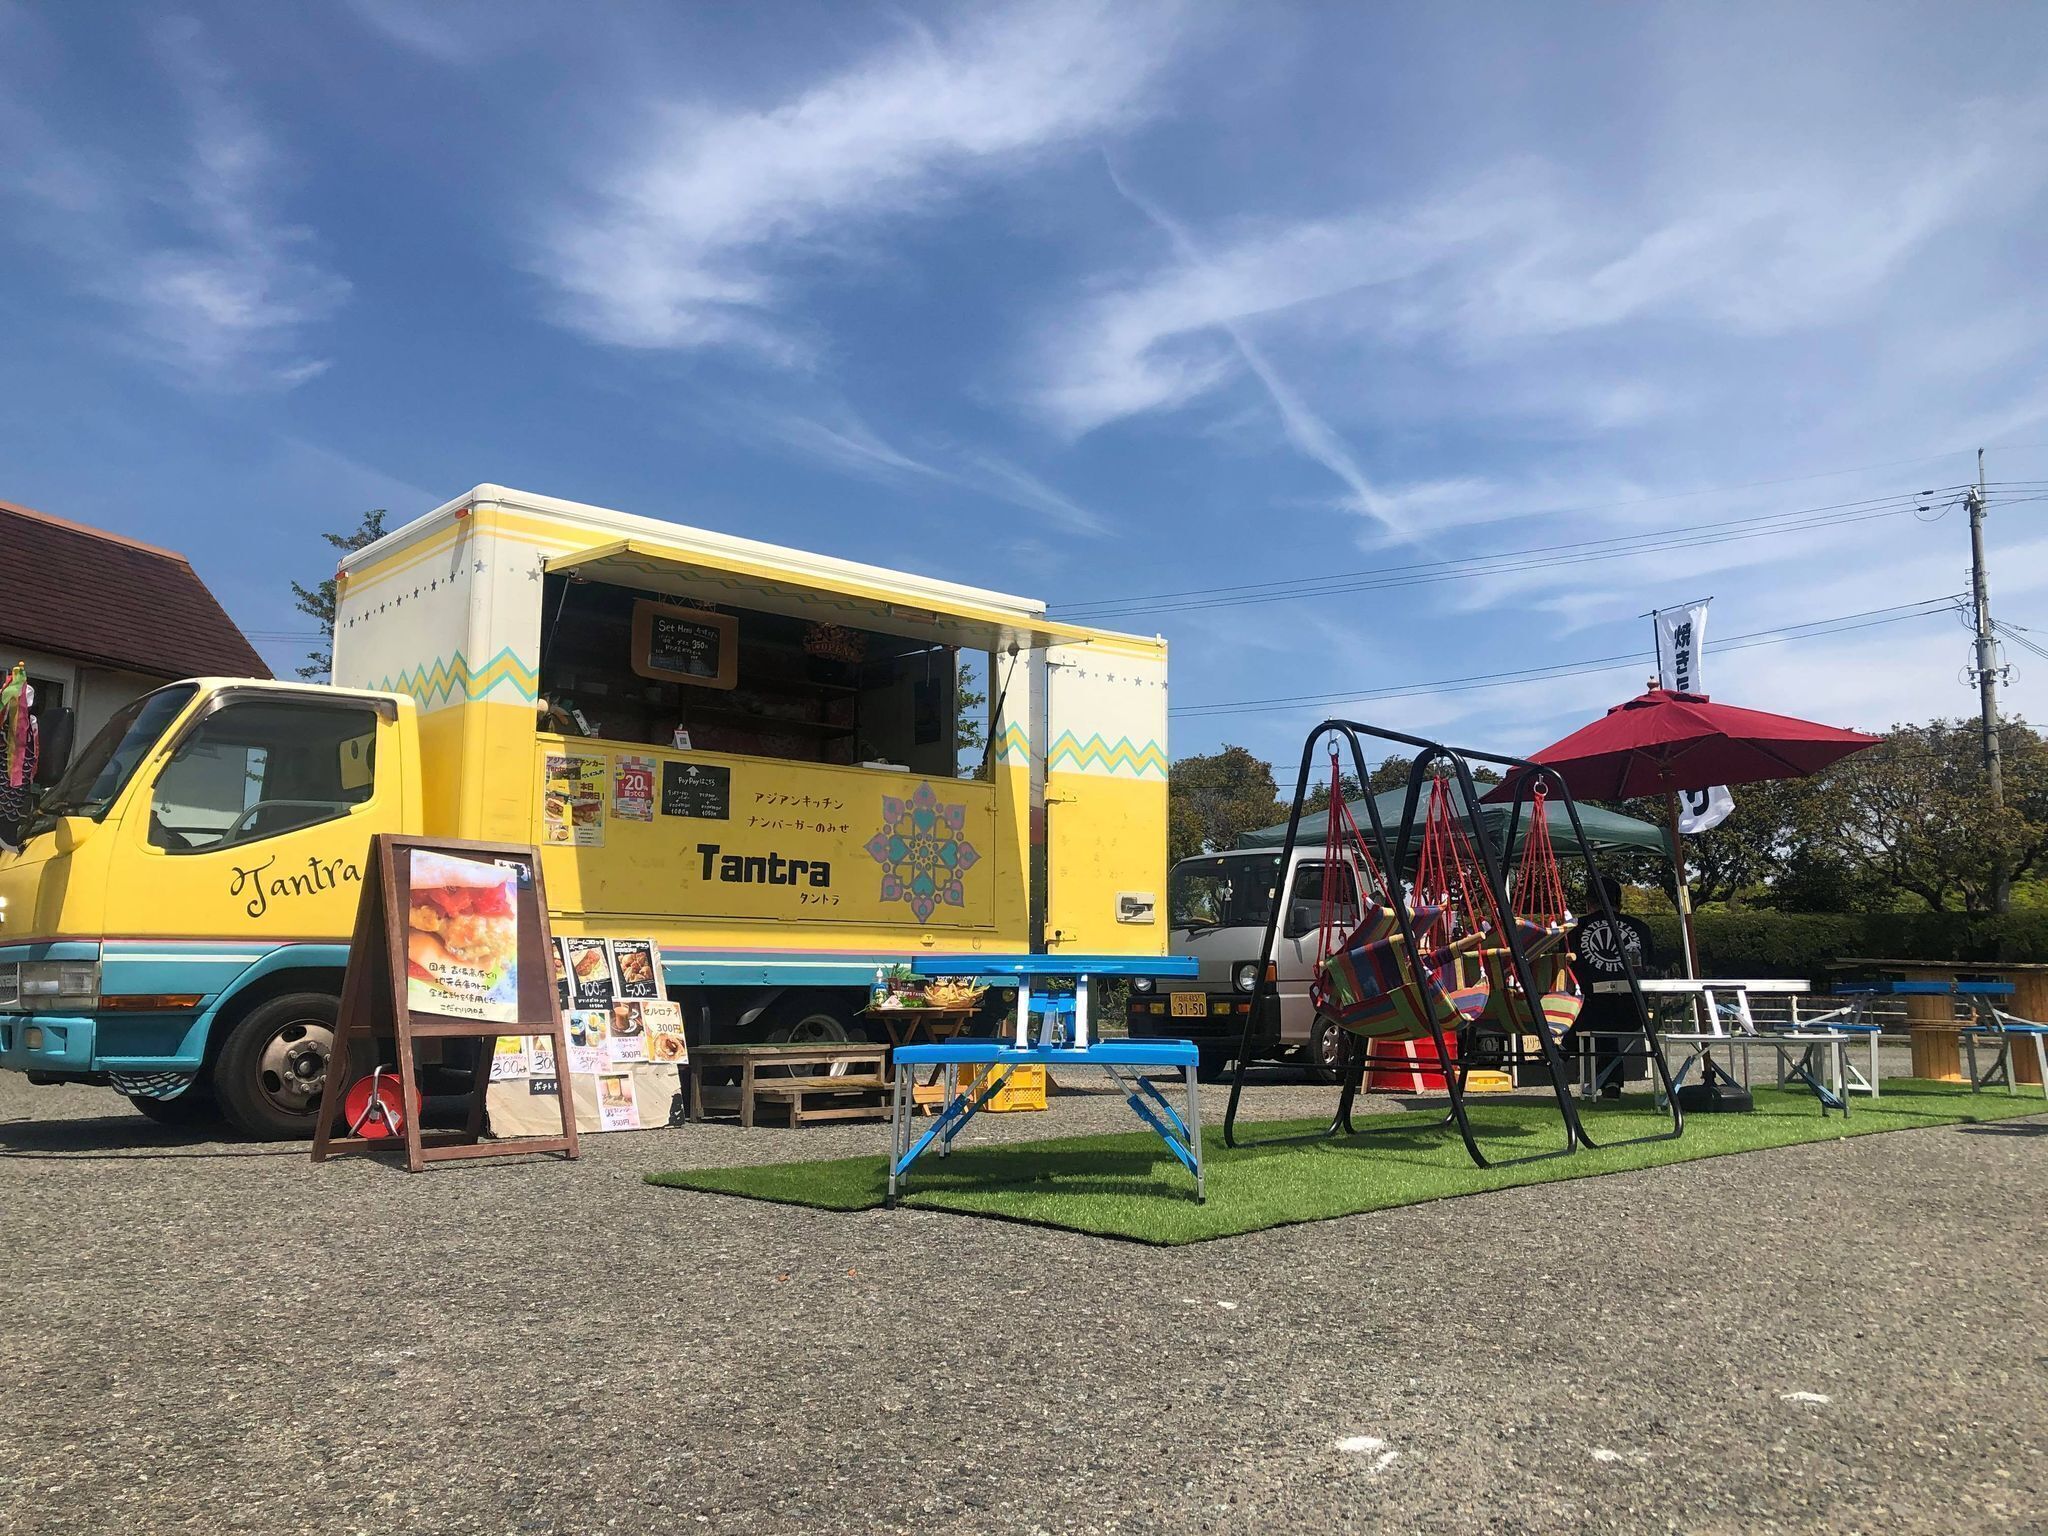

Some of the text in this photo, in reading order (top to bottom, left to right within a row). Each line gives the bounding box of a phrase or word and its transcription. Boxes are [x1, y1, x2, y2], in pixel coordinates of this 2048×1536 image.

[658, 619, 675, 633] Set
[754, 792, 844, 811] アジアンキッチン
[747, 816, 850, 834] ナンバーガーのみせ
[696, 843, 831, 888] Tantra
[230, 854, 362, 918] Tantra
[799, 893, 840, 906] タントラ
[1588, 920, 1609, 930] YES
[1580, 928, 1604, 969] BALLOON
[644, 1007, 680, 1016] セルロティ
[1178, 1002, 1204, 1015] 31-50
[656, 1023, 681, 1033] 300円
[620, 1050, 641, 1058] 300円
